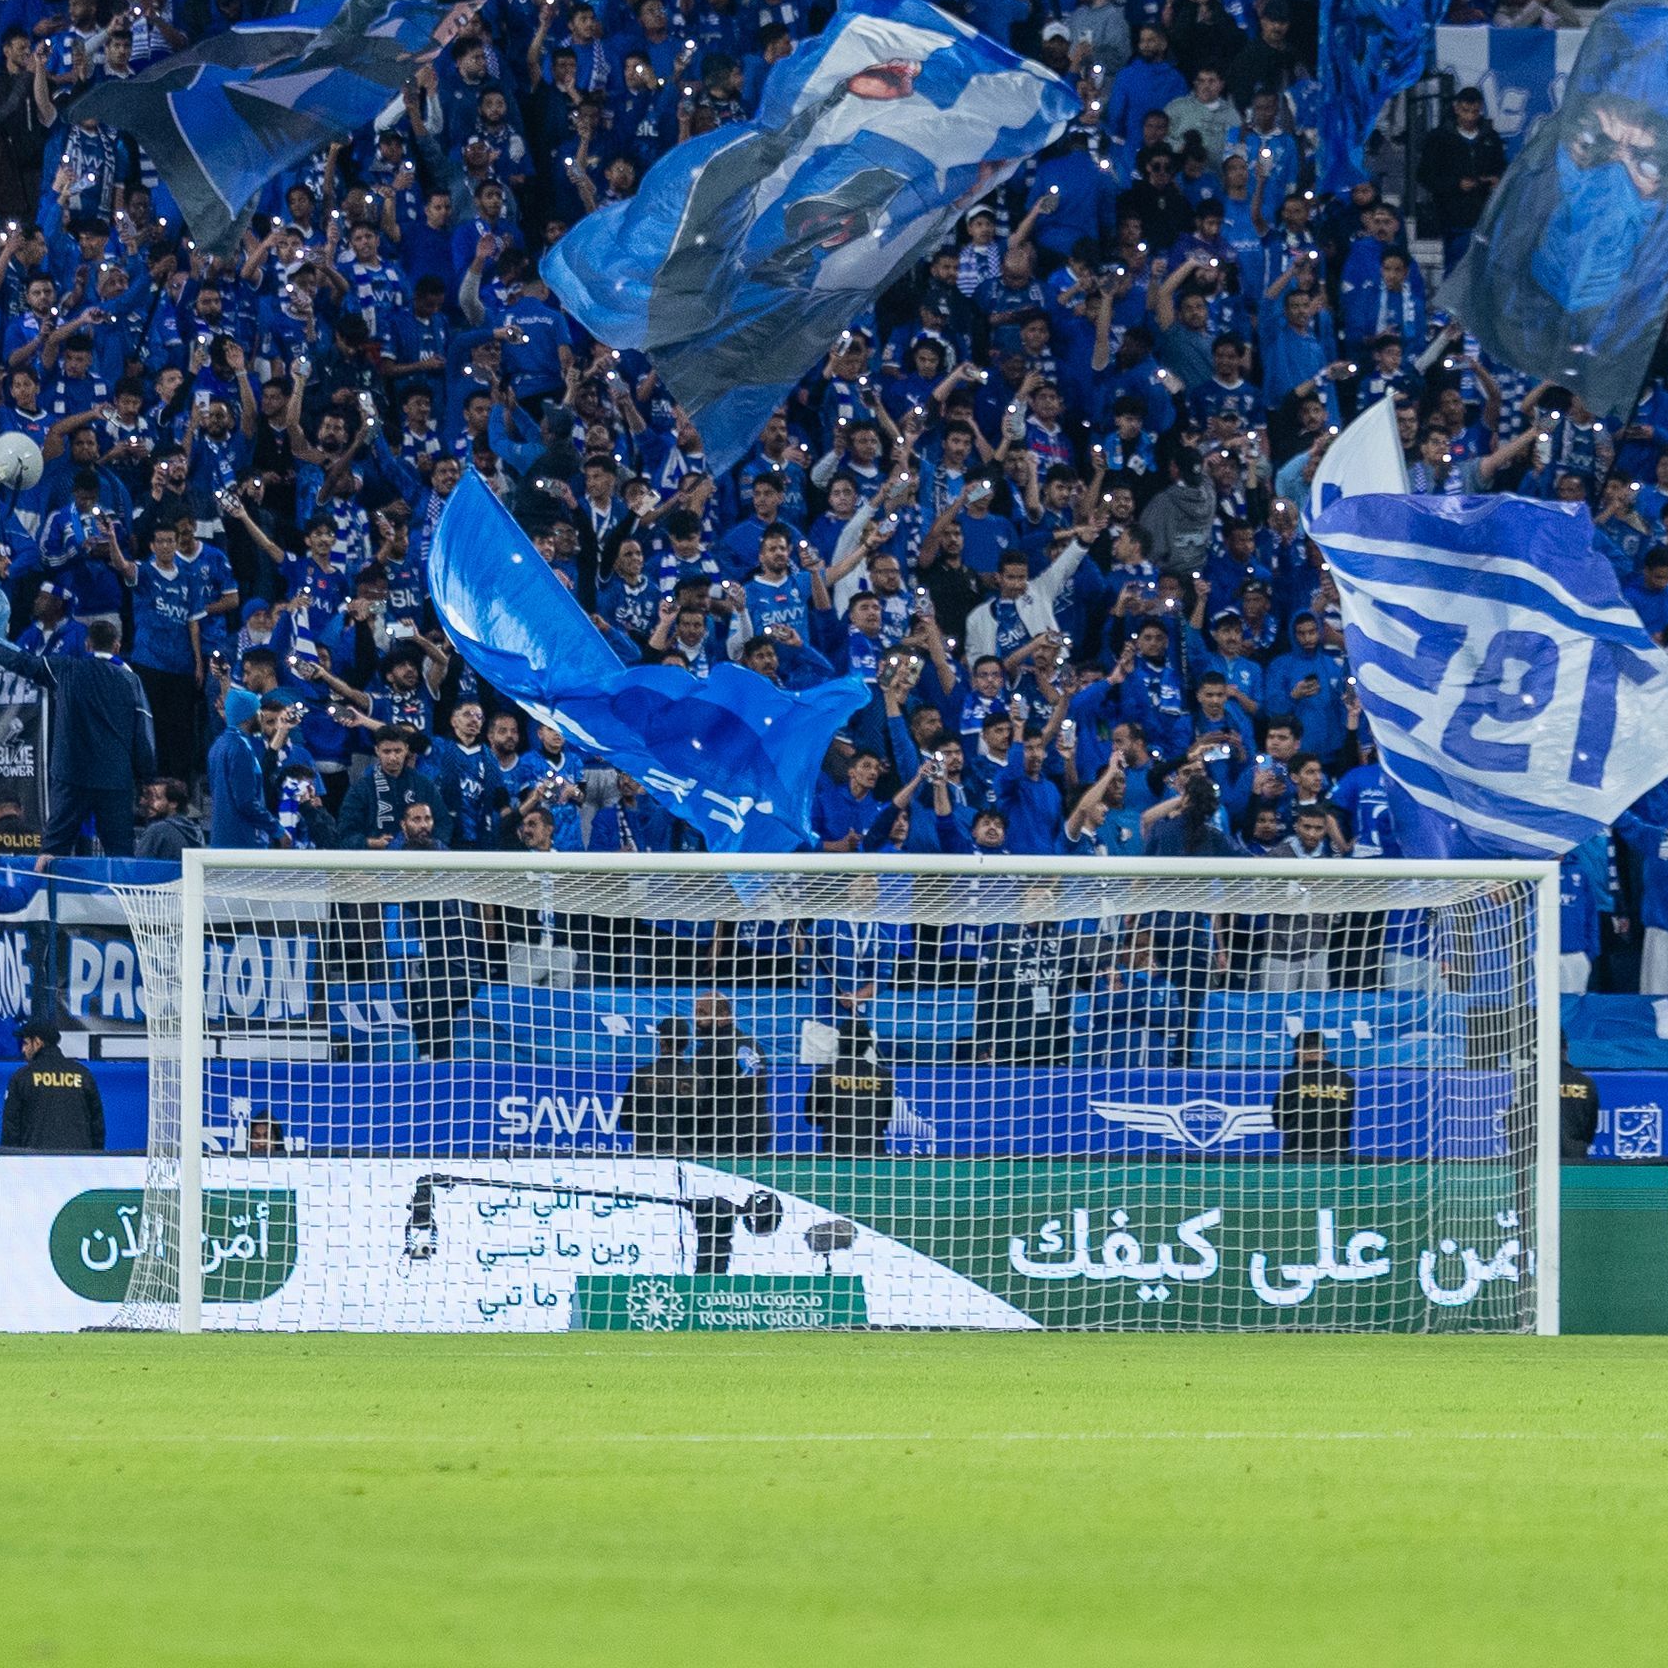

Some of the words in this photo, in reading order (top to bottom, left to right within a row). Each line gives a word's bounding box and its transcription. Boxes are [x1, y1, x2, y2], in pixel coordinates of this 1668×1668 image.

[156, 597, 190, 617] SAVVY
[762, 608, 806, 625] SAVVY
[70, 935, 309, 1020] PAION
[33, 1071, 82, 1088] POLICE
[830, 1076, 882, 1092] POLICE
[1299, 1083, 1348, 1100] POLICE
[1560, 1083, 1587, 1099] LICE
[499, 1097, 624, 1136] SAVV
[556, 1234, 580, 1256] ما
[1010, 1208, 1221, 1303] كيفك
[1250, 1208, 1390, 1307] على
[699, 1311, 764, 1326] ROSHN
[767, 1311, 826, 1328] GROUP
